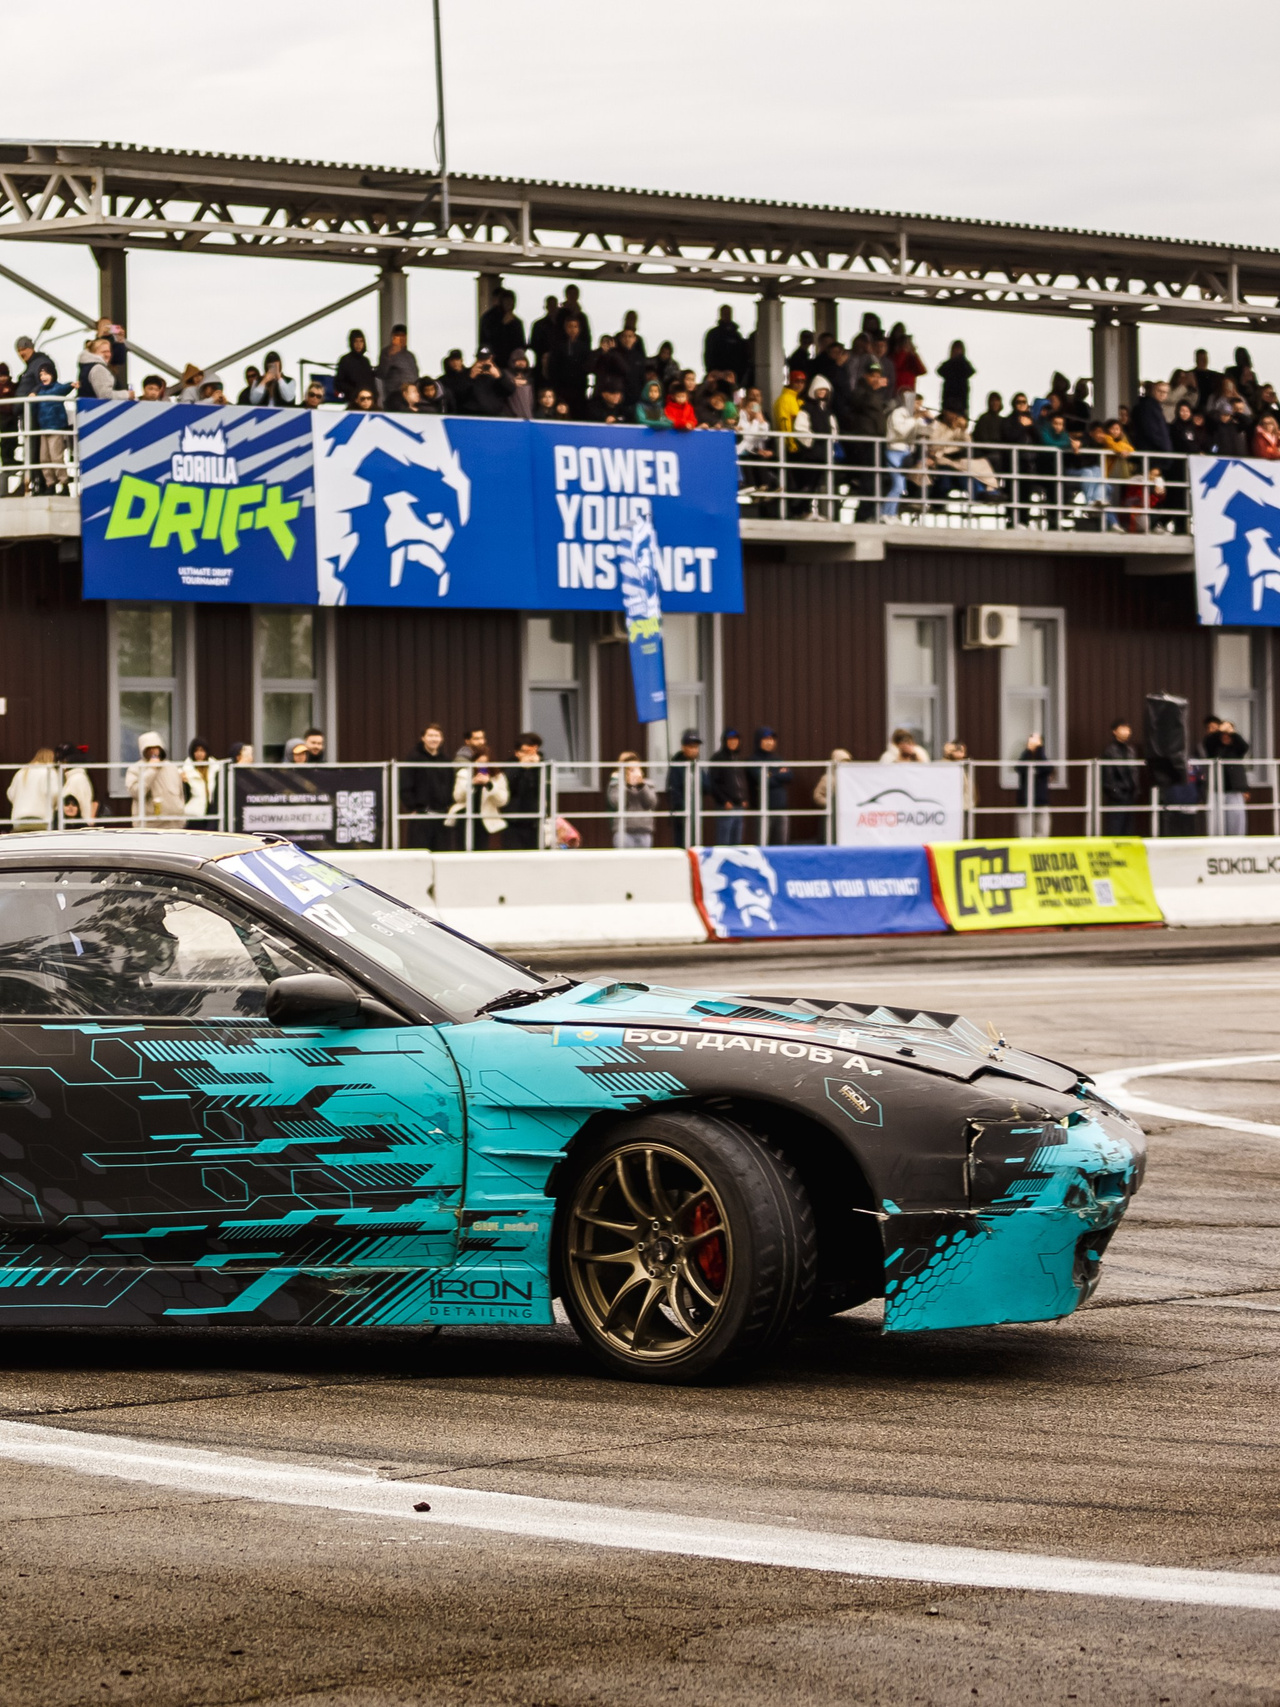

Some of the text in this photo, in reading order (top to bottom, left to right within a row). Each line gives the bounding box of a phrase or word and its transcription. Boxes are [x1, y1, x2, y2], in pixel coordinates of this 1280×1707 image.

[171, 454, 238, 485] GORILLA
[554, 446, 680, 496] POWER
[104, 474, 301, 561] DRIFT
[557, 542, 717, 592] INSNCT
[248, 813, 327, 823] SHOWMARKET.KZ
[1029, 852, 1079, 872] ШКОЛА
[786, 877, 919, 898] POWER YOUR INSTINCT
[1035, 875, 1090, 895] ДРИФТА
[624, 1028, 833, 1064] БОГДАНОВ
[841, 1084, 871, 1112] IRON
[430, 1279, 532, 1300] IRON
[430, 1306, 532, 1319] DETAILING
